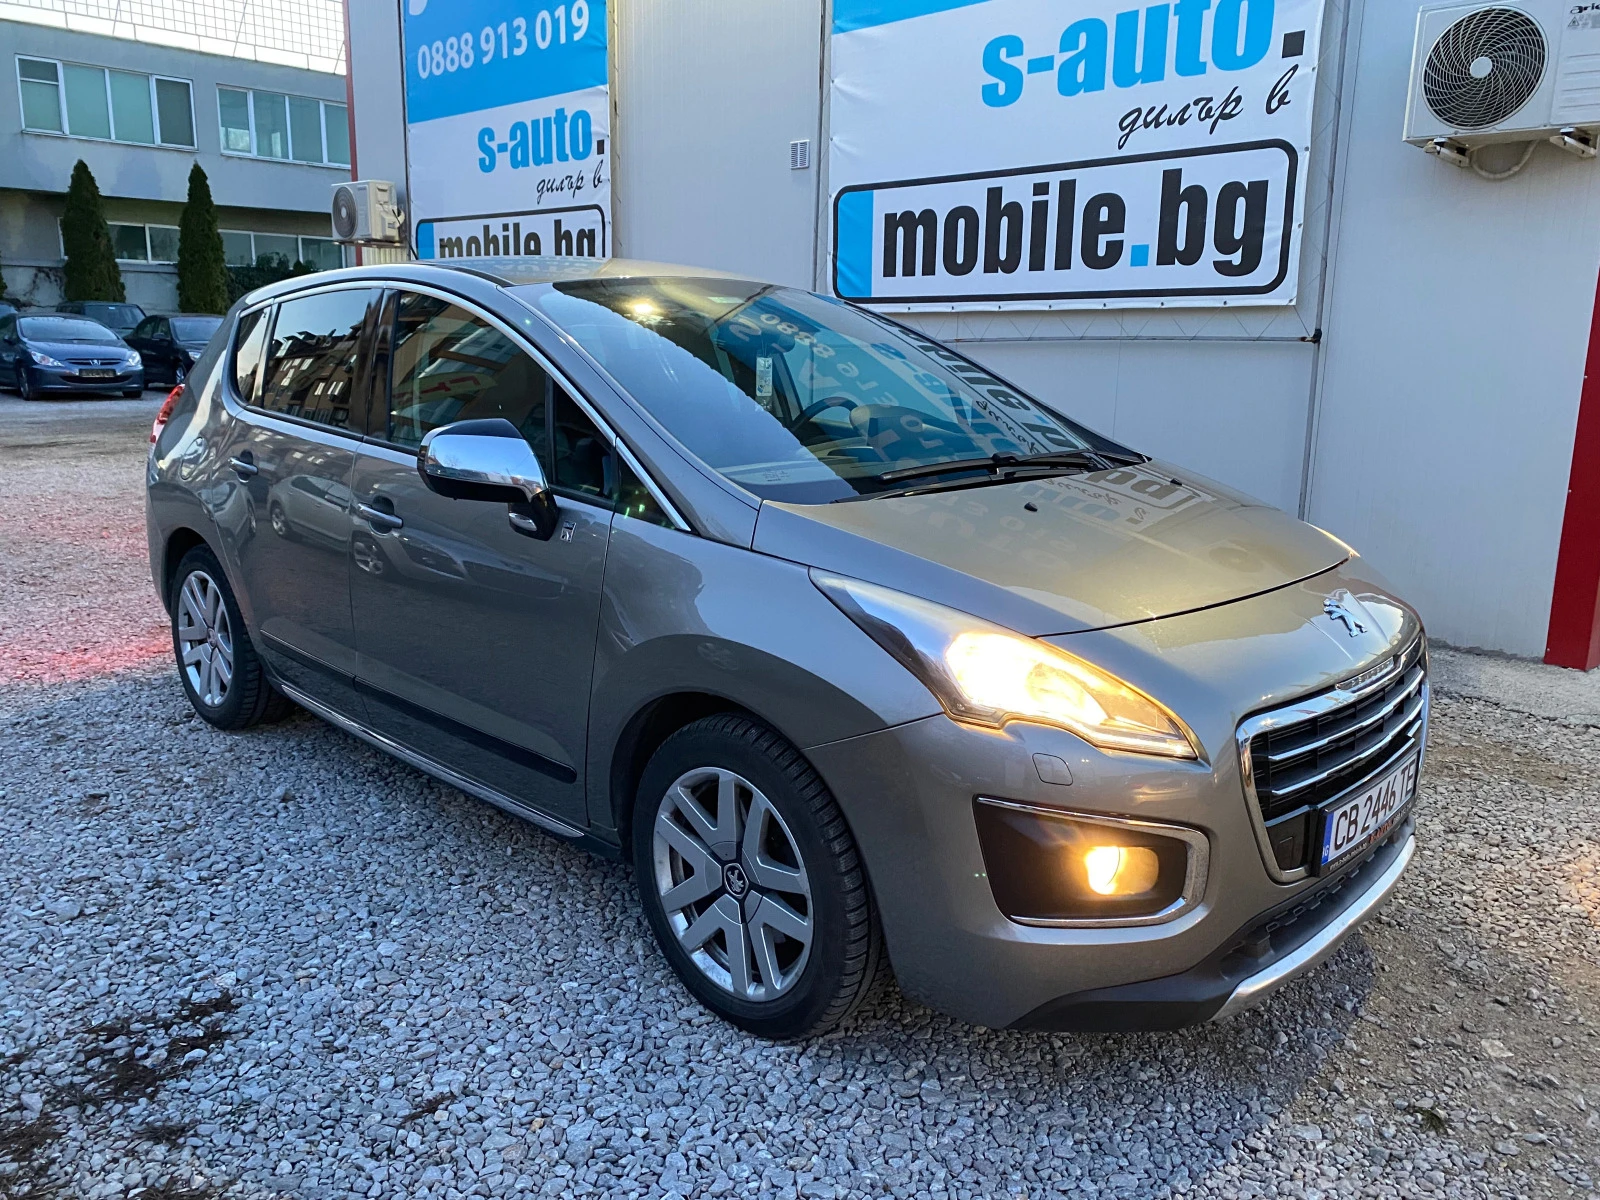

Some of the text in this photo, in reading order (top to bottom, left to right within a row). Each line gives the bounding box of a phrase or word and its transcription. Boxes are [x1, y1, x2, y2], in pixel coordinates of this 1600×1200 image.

[417, 0, 590, 79] 0888 913 019
[477, 107, 605, 173] s-auto.
[1117, 64, 1299, 150] дилър в
[536, 170, 585, 205] дилър
[882, 168, 1270, 278] mobile.bg
[1334, 803, 1359, 851] CB
[1360, 774, 1397, 835] 2446
[1399, 758, 1416, 803] TE
